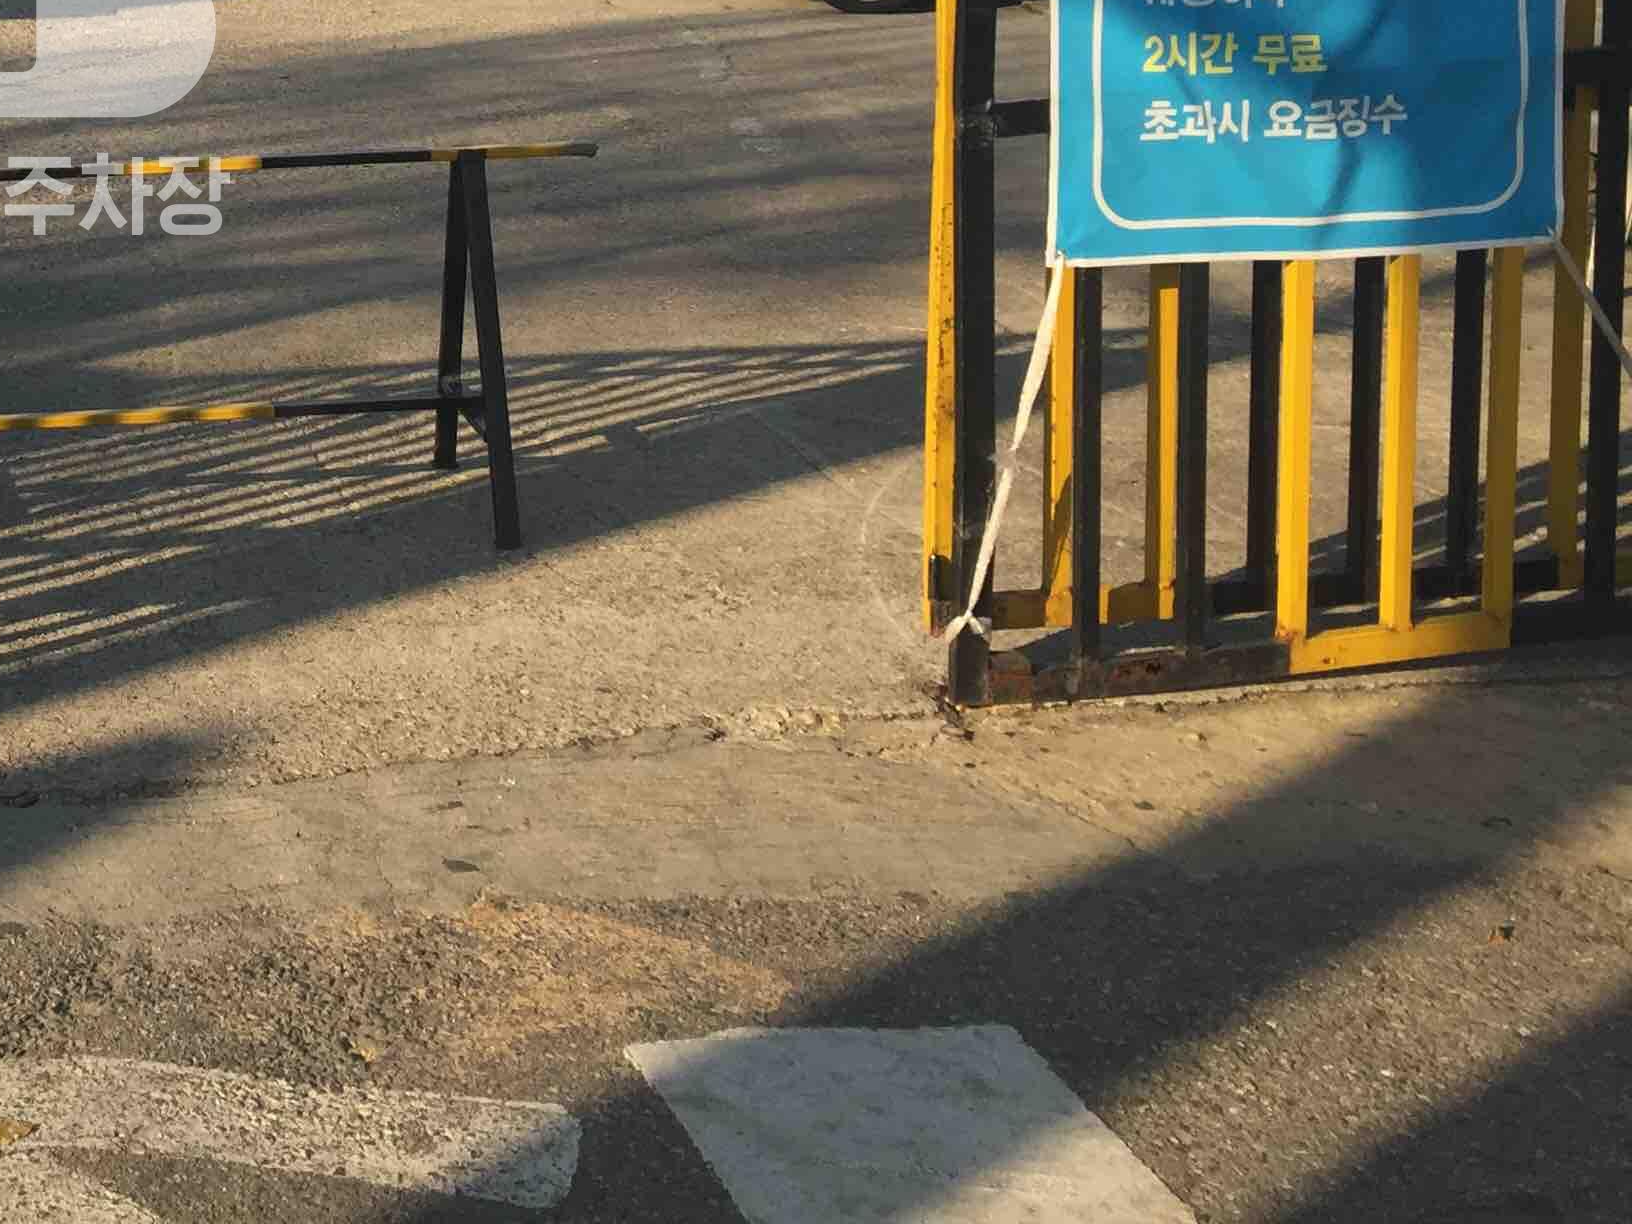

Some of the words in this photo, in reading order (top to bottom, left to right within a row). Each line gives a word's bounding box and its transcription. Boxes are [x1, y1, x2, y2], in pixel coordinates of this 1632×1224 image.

[1142, 32, 1238, 75] 2시간
[1253, 33, 1328, 74] 무료
[1140, 99, 1250, 144] 초과시
[1264, 95, 1408, 141] 요금징수
